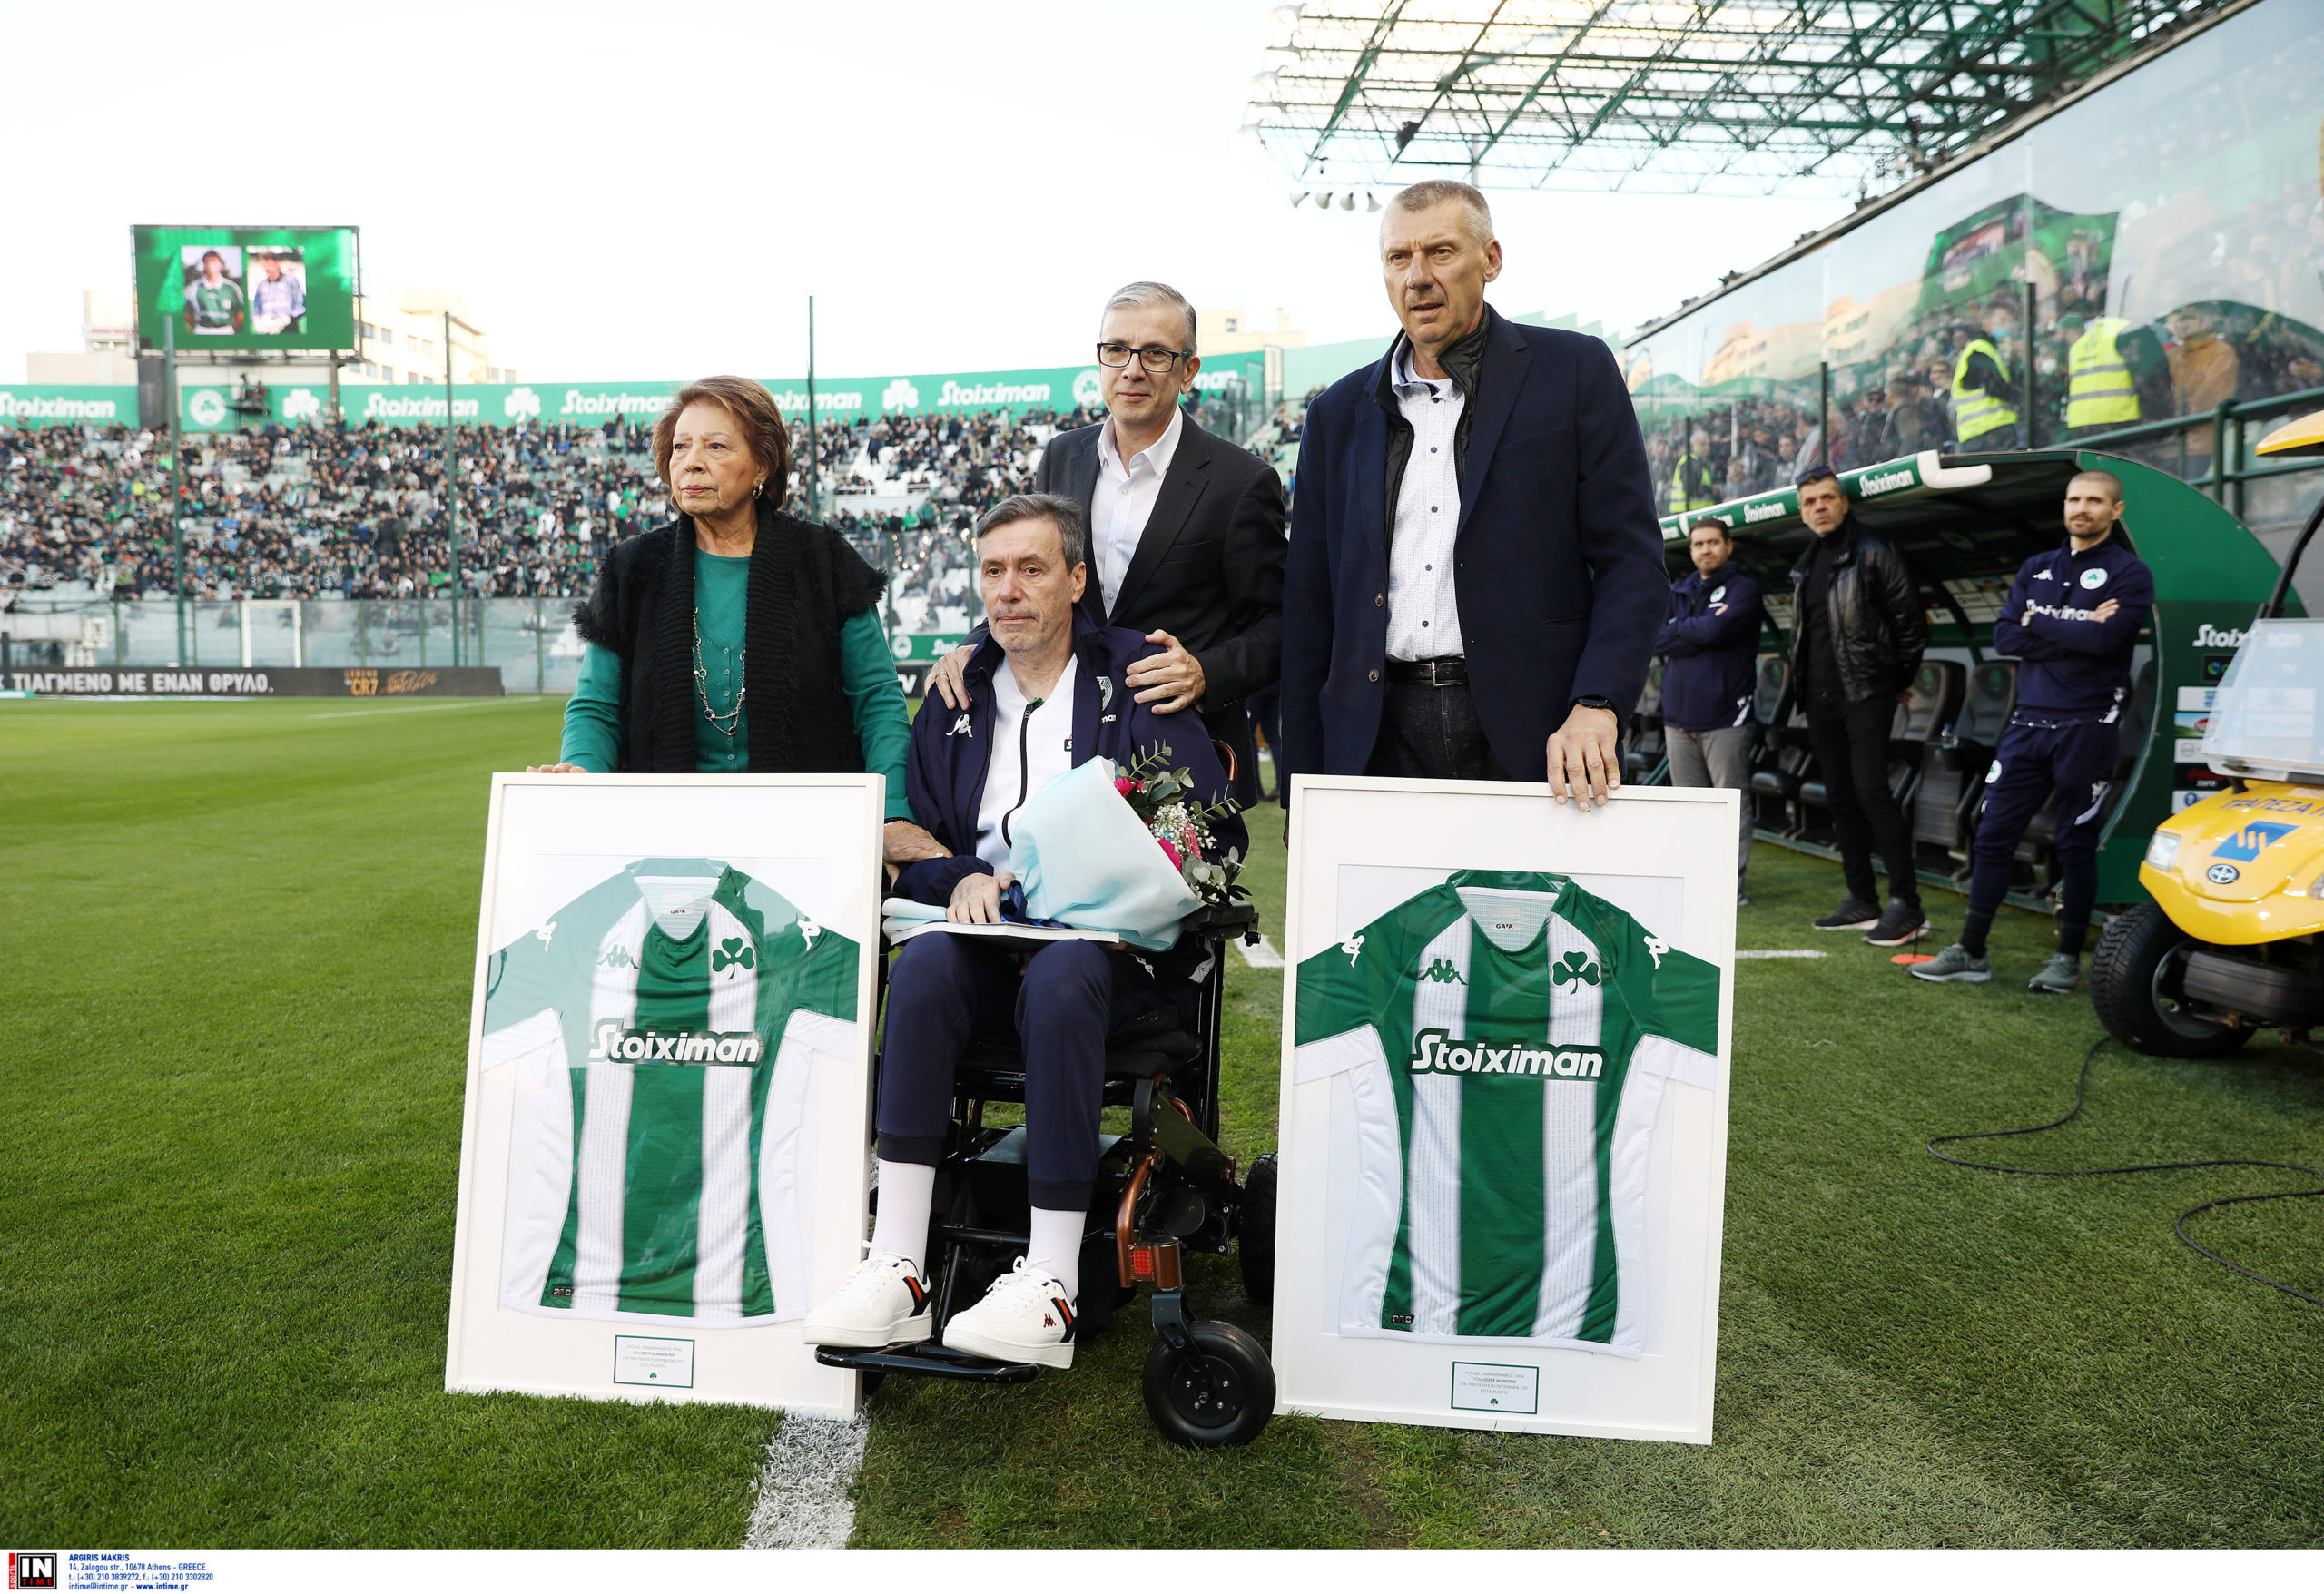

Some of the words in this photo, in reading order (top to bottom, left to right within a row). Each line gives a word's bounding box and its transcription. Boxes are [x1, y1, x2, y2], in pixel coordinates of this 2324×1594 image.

[0, 391, 117, 418] Stoiximan
[364, 393, 479, 418] Stoiximan
[937, 380, 1050, 407] Stoiximan
[1858, 469, 1915, 497] Stoiximan
[588, 1024, 760, 1062] Stoiximan
[1411, 1034, 1603, 1077] Stoiximan
